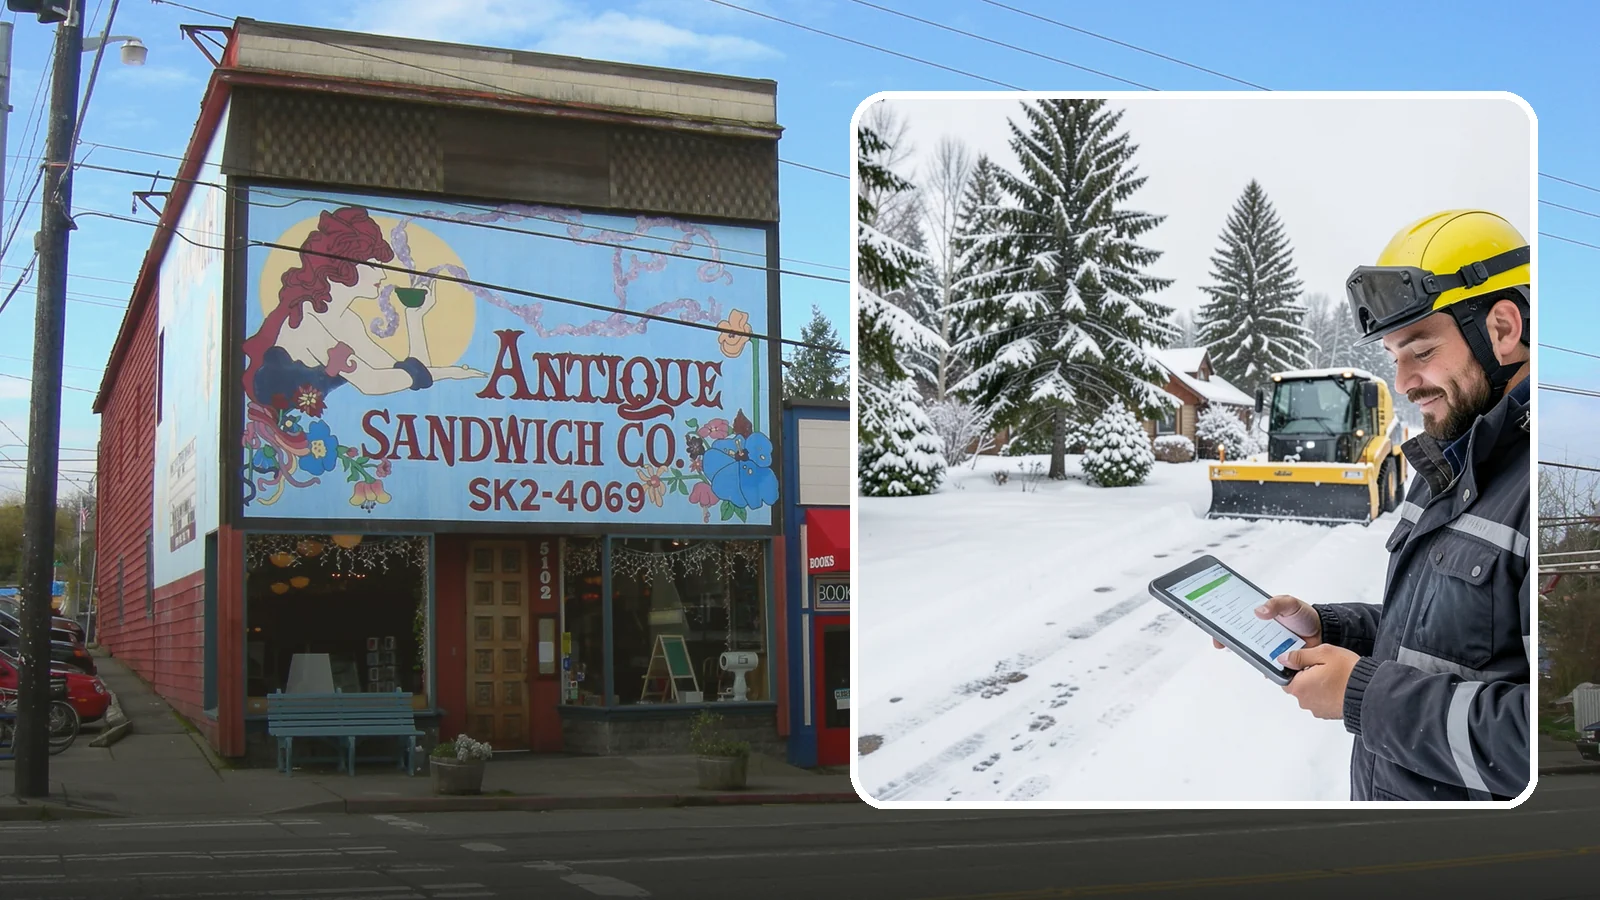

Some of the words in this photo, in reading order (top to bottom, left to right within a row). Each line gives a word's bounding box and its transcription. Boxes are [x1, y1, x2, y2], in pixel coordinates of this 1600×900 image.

[476, 328, 724, 421] ANTIQUE
[361, 409, 605, 468] SANDWICH
[617, 421, 685, 468] CO.
[468, 477, 646, 513] SK2-4069
[809, 555, 835, 569] BOOKS
